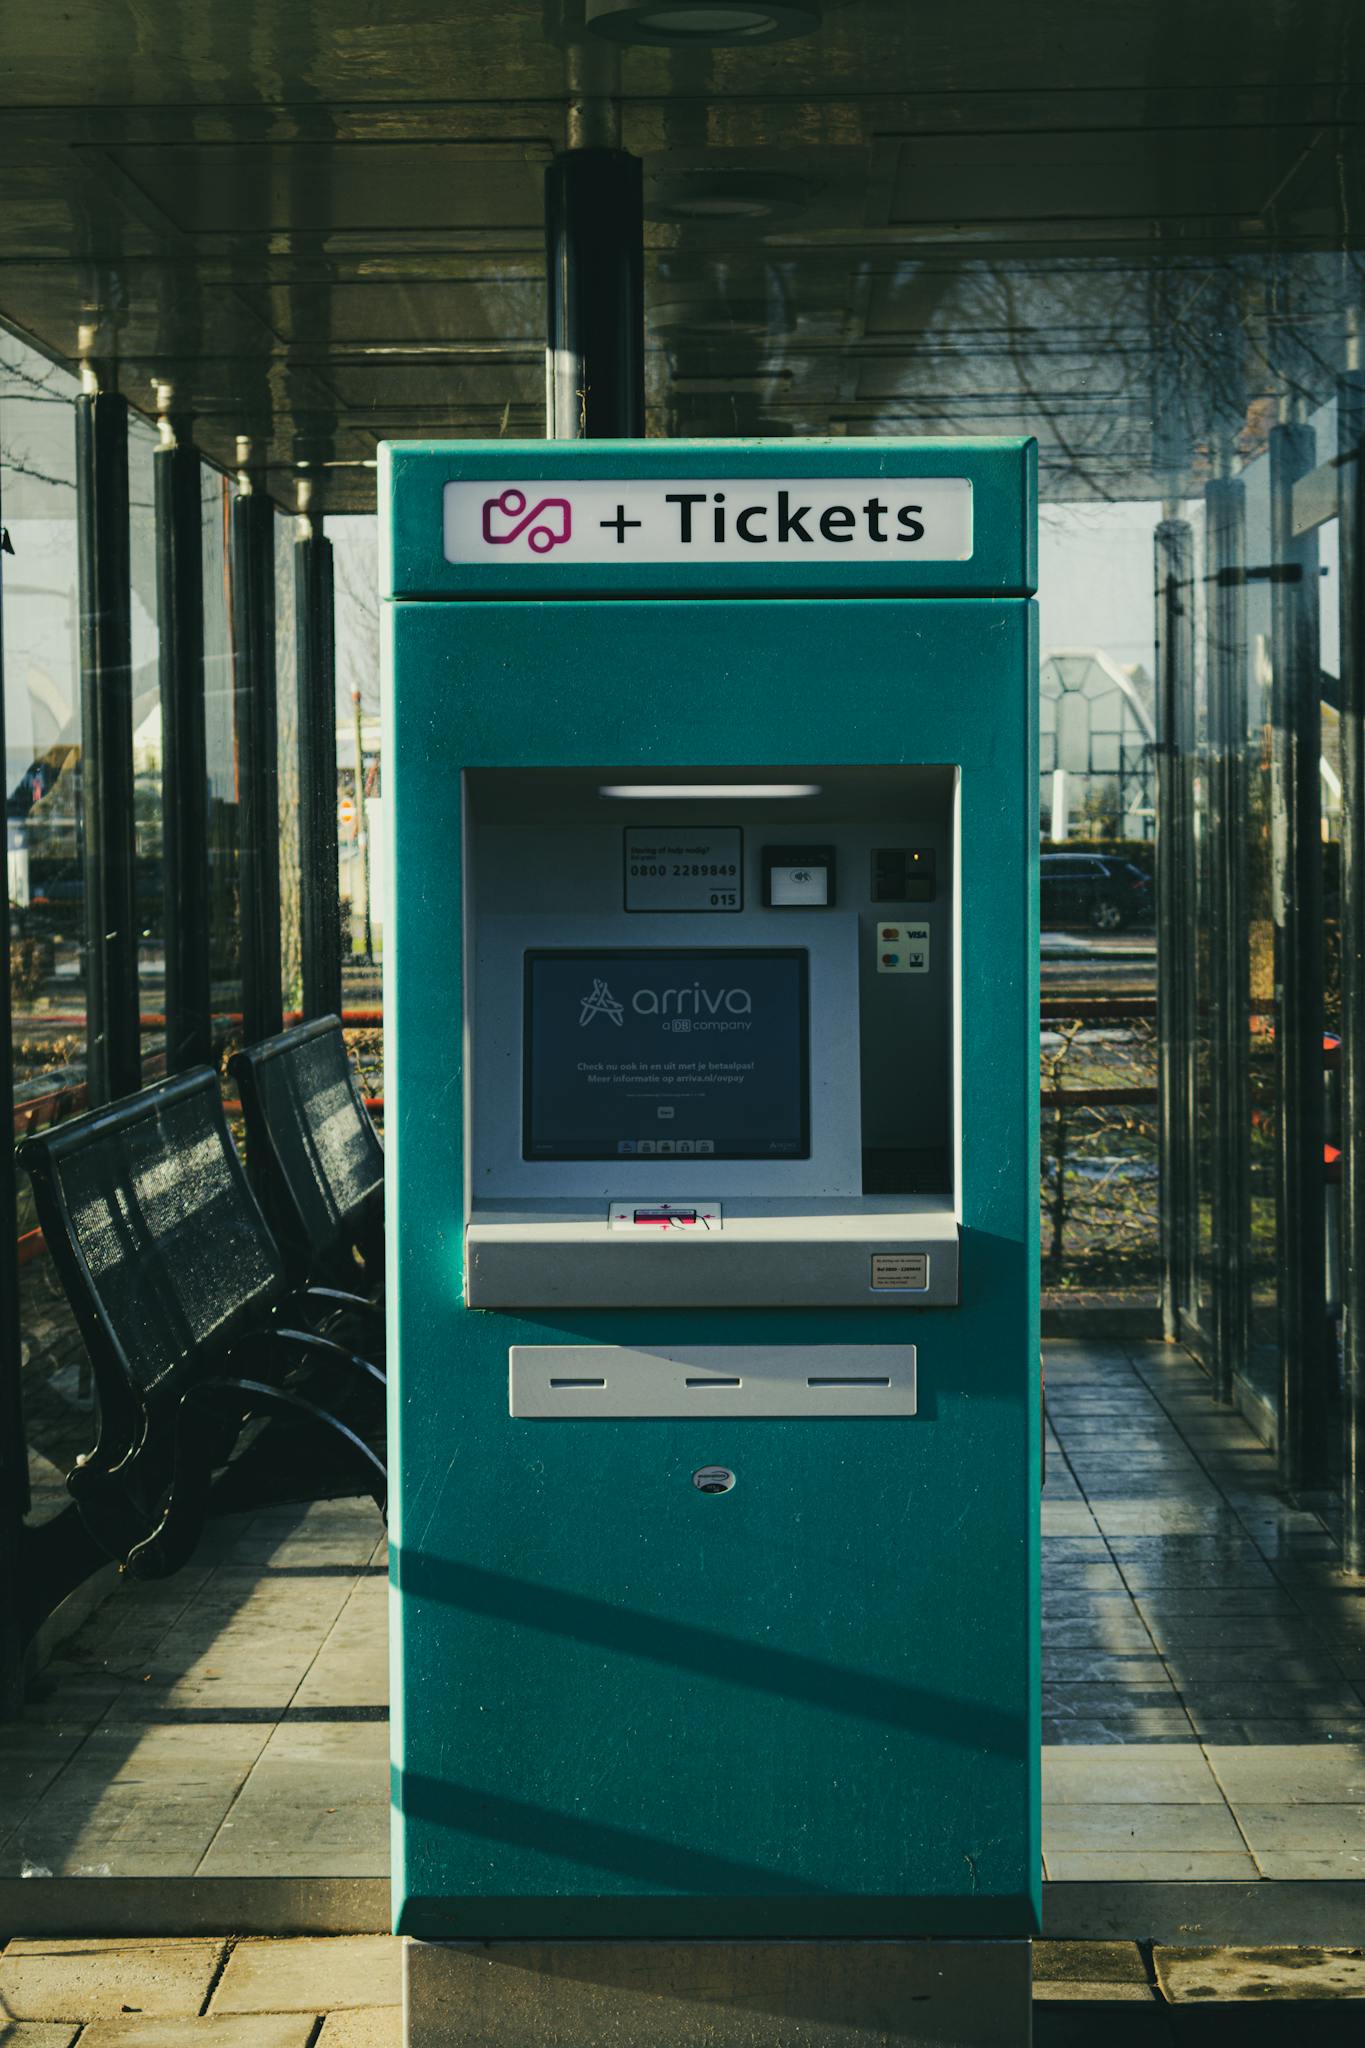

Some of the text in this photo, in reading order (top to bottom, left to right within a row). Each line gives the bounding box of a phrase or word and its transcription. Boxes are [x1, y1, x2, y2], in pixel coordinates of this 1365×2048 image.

[665, 490, 926, 544] Tickets
[630, 864, 737, 877] 0800 2289849
[710, 893, 737, 906] 015
[907, 930, 928, 940] VISA
[631, 981, 752, 1015] arriva
[662, 1022, 671, 1030] a
[693, 1021, 752, 1033] company
[577, 1062, 604, 1071] Check
[620, 1062, 637, 1071] ook
[639, 1062, 648, 1071] in
[663, 1062, 676, 1071] uit
[678, 1063, 696, 1071] met
[587, 1073, 745, 1085] Meer informatie op arriva.nl/ovpay
